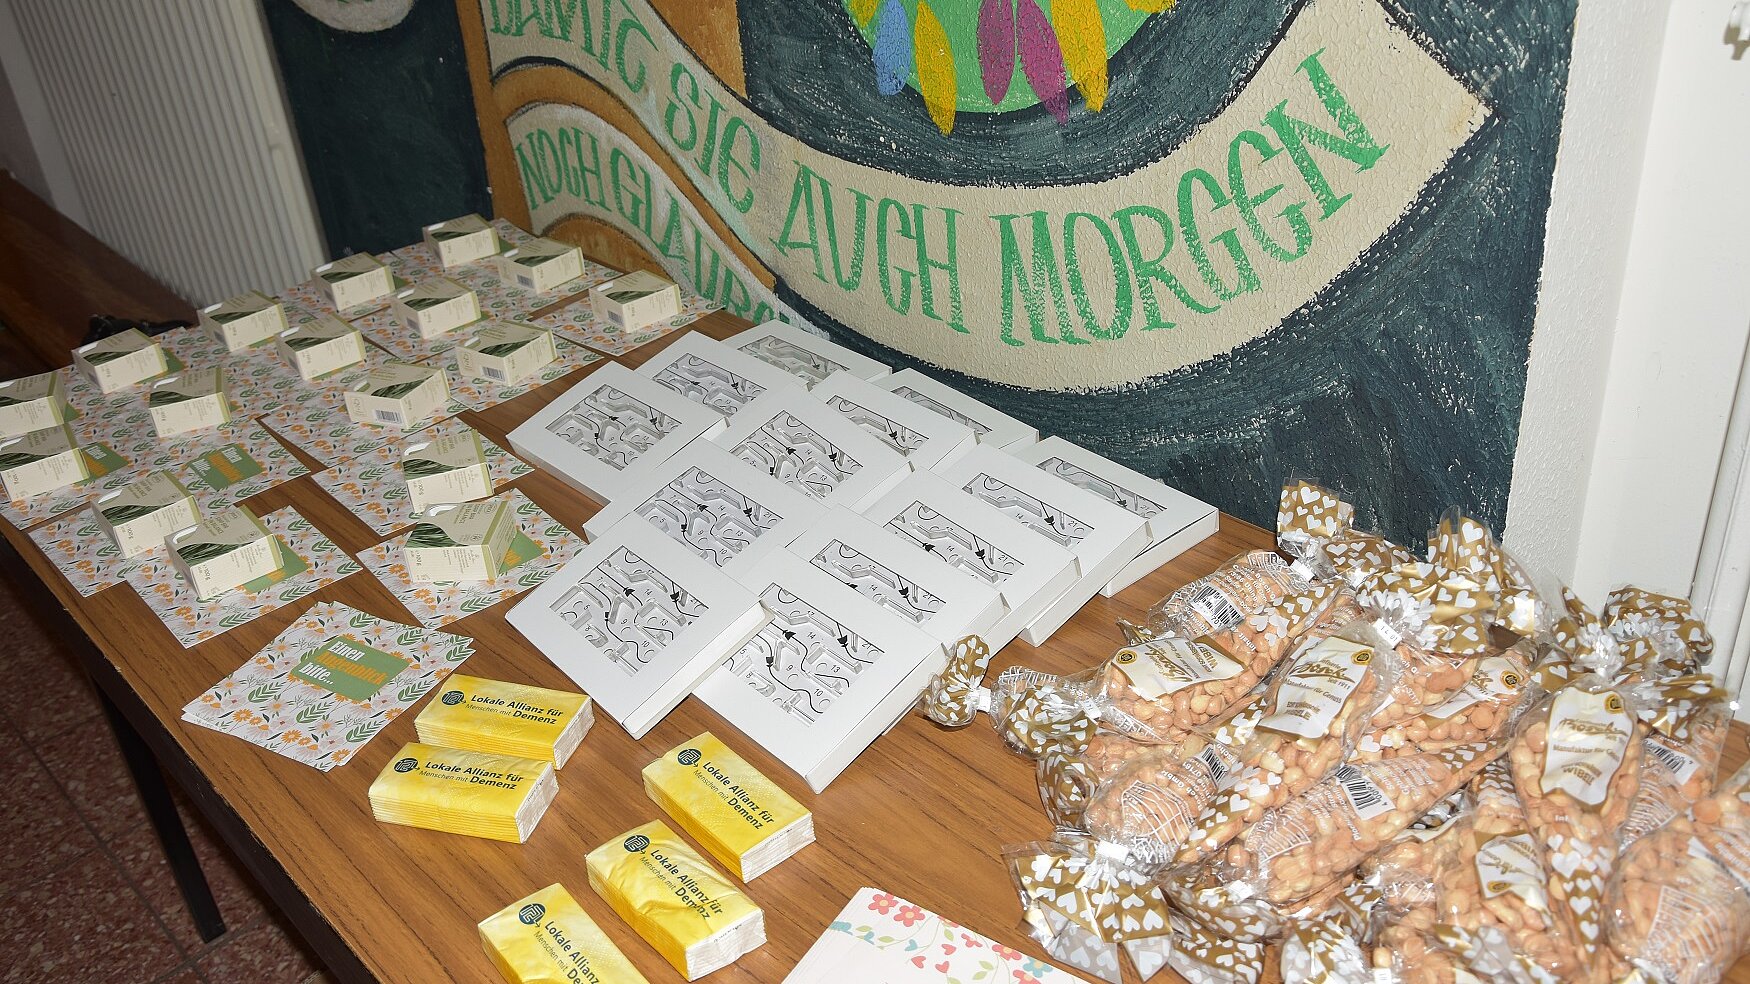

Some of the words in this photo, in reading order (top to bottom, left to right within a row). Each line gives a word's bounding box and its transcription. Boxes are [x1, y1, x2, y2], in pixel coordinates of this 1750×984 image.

[664, 62, 761, 214] SIE
[988, 48, 1391, 347] MORGEN
[328, 640, 365, 661] Einen
[1239, 633, 1257, 652] Inhalt
[470, 694, 505, 706] Lokale
[506, 701, 544, 715] Allianz
[547, 708, 564, 718] für
[1322, 691, 1342, 704] Genuss
[465, 703, 499, 714] Menschen
[512, 710, 557, 725] Demenz
[419, 770, 454, 780] Menschen
[469, 775, 517, 790] Demenz
[425, 761, 462, 773] Lokale
[463, 767, 503, 780] Allianz
[505, 773, 524, 783] für
[693, 769, 718, 795] Menschen
[717, 789, 730, 801] mit
[727, 797, 764, 830] Demenz
[702, 761, 731, 785] Lokale
[729, 784, 760, 812] Allianz
[759, 809, 775, 825] für
[639, 856, 667, 883] Menschen
[665, 879, 677, 891] mit
[650, 849, 678, 876] Lokale
[677, 873, 709, 905] Allianz
[706, 899, 724, 916] für
[533, 930, 559, 962] Menschen
[557, 958, 569, 972] mit
[544, 920, 572, 952] Lokale
[568, 951, 600, 984] Allianz
